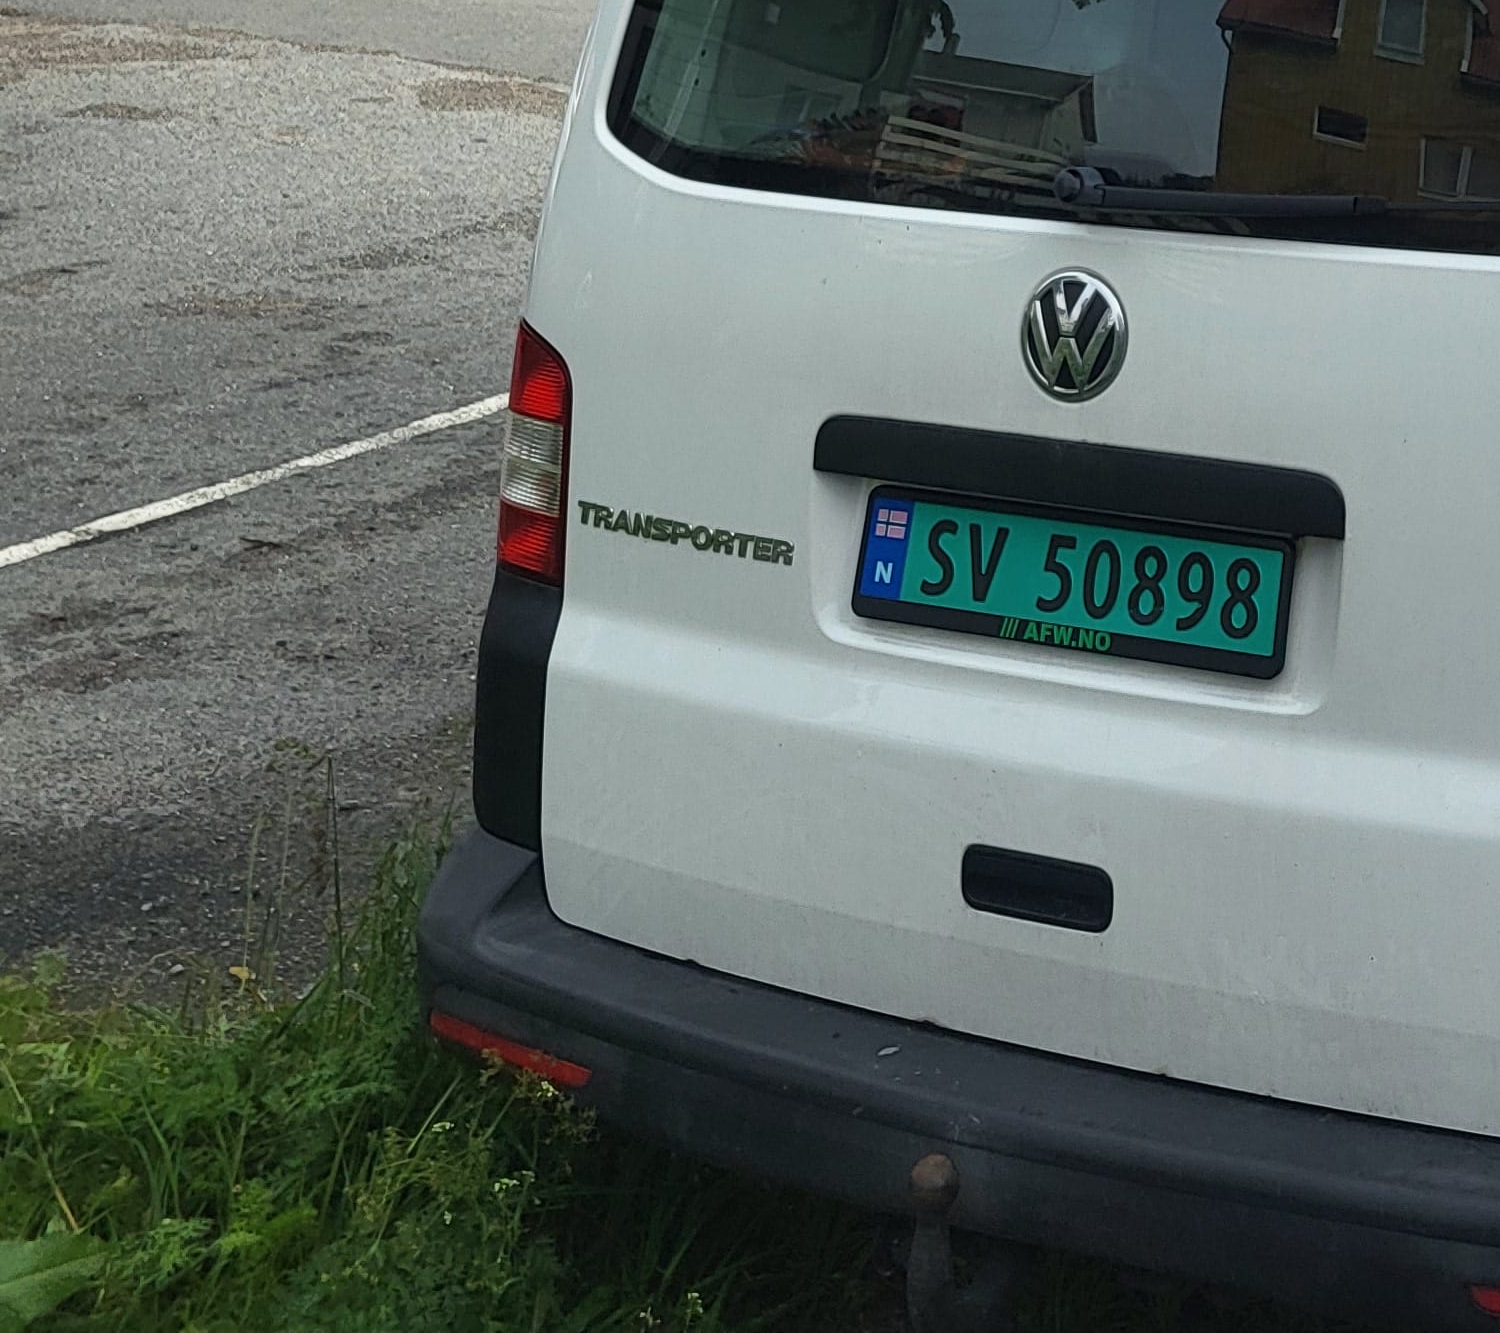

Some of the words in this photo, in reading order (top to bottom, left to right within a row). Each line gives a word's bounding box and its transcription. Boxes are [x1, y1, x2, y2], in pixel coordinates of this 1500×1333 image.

[578, 500, 795, 566] TRANSPORTER
[874, 561, 892, 585] N
[920, 519, 1010, 603] SV
[1036, 534, 1262, 639] 50898
[1023, 621, 1112, 652] AFW.NO
